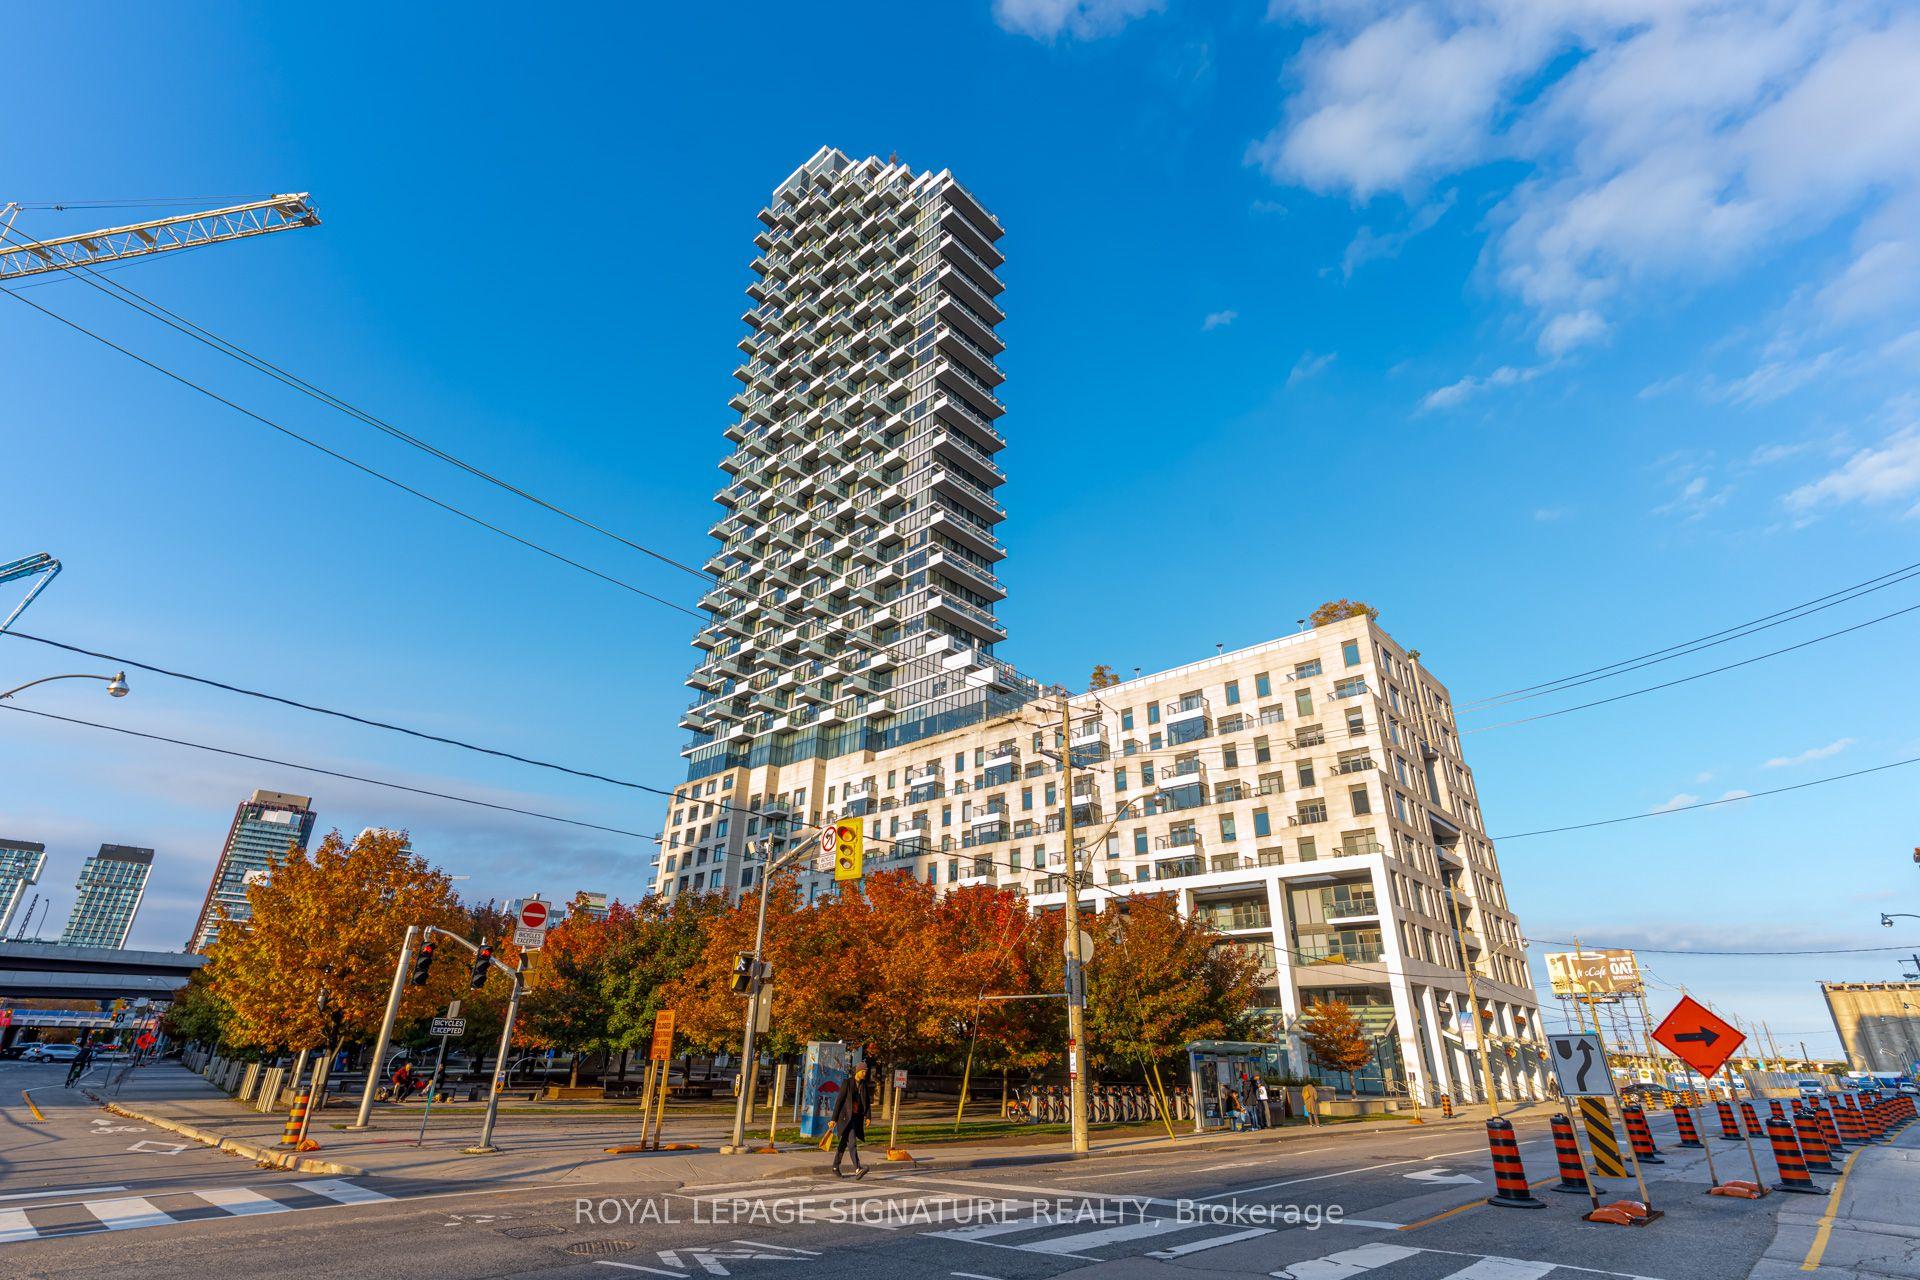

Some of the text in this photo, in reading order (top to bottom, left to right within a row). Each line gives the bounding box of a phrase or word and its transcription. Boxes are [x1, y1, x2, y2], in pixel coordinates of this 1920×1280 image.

[518, 931, 541, 939] BICYCLES
[1610, 961, 1633, 975] OAT
[432, 1026, 462, 1034] EXCEPTED
